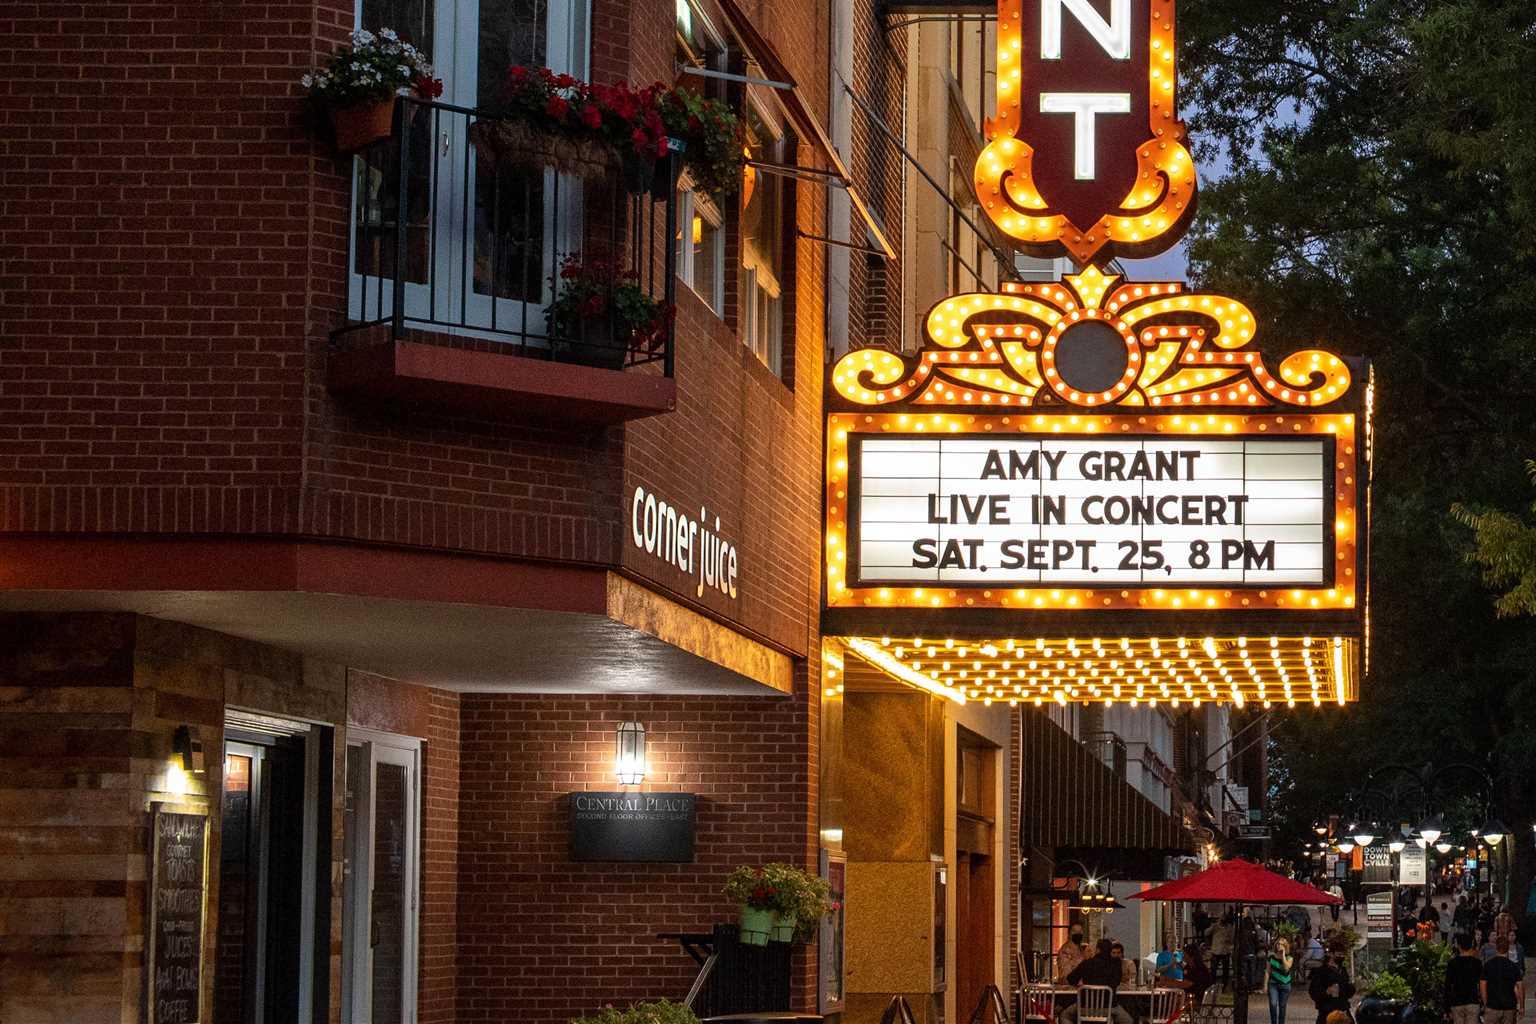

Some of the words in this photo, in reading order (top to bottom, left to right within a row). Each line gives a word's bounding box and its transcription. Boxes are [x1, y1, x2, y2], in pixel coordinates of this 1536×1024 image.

[980, 449, 1067, 482] AMY
[1079, 449, 1201, 482] GRANT
[927, 493, 1010, 525] LIVE
[1031, 494, 1067, 525] IN
[1080, 494, 1249, 526] CONCERT
[632, 486, 697, 574] corner
[697, 506, 737, 599] juice
[912, 538, 987, 573] SAT.
[1000, 538, 1098, 573] SEPT.
[1117, 539, 1173, 576] 25,
[1188, 538, 1211, 569] 8
[1221, 539, 1276, 571] PM
[576, 796, 642, 812] CENTRAL
[646, 796, 689, 812] PLACE
